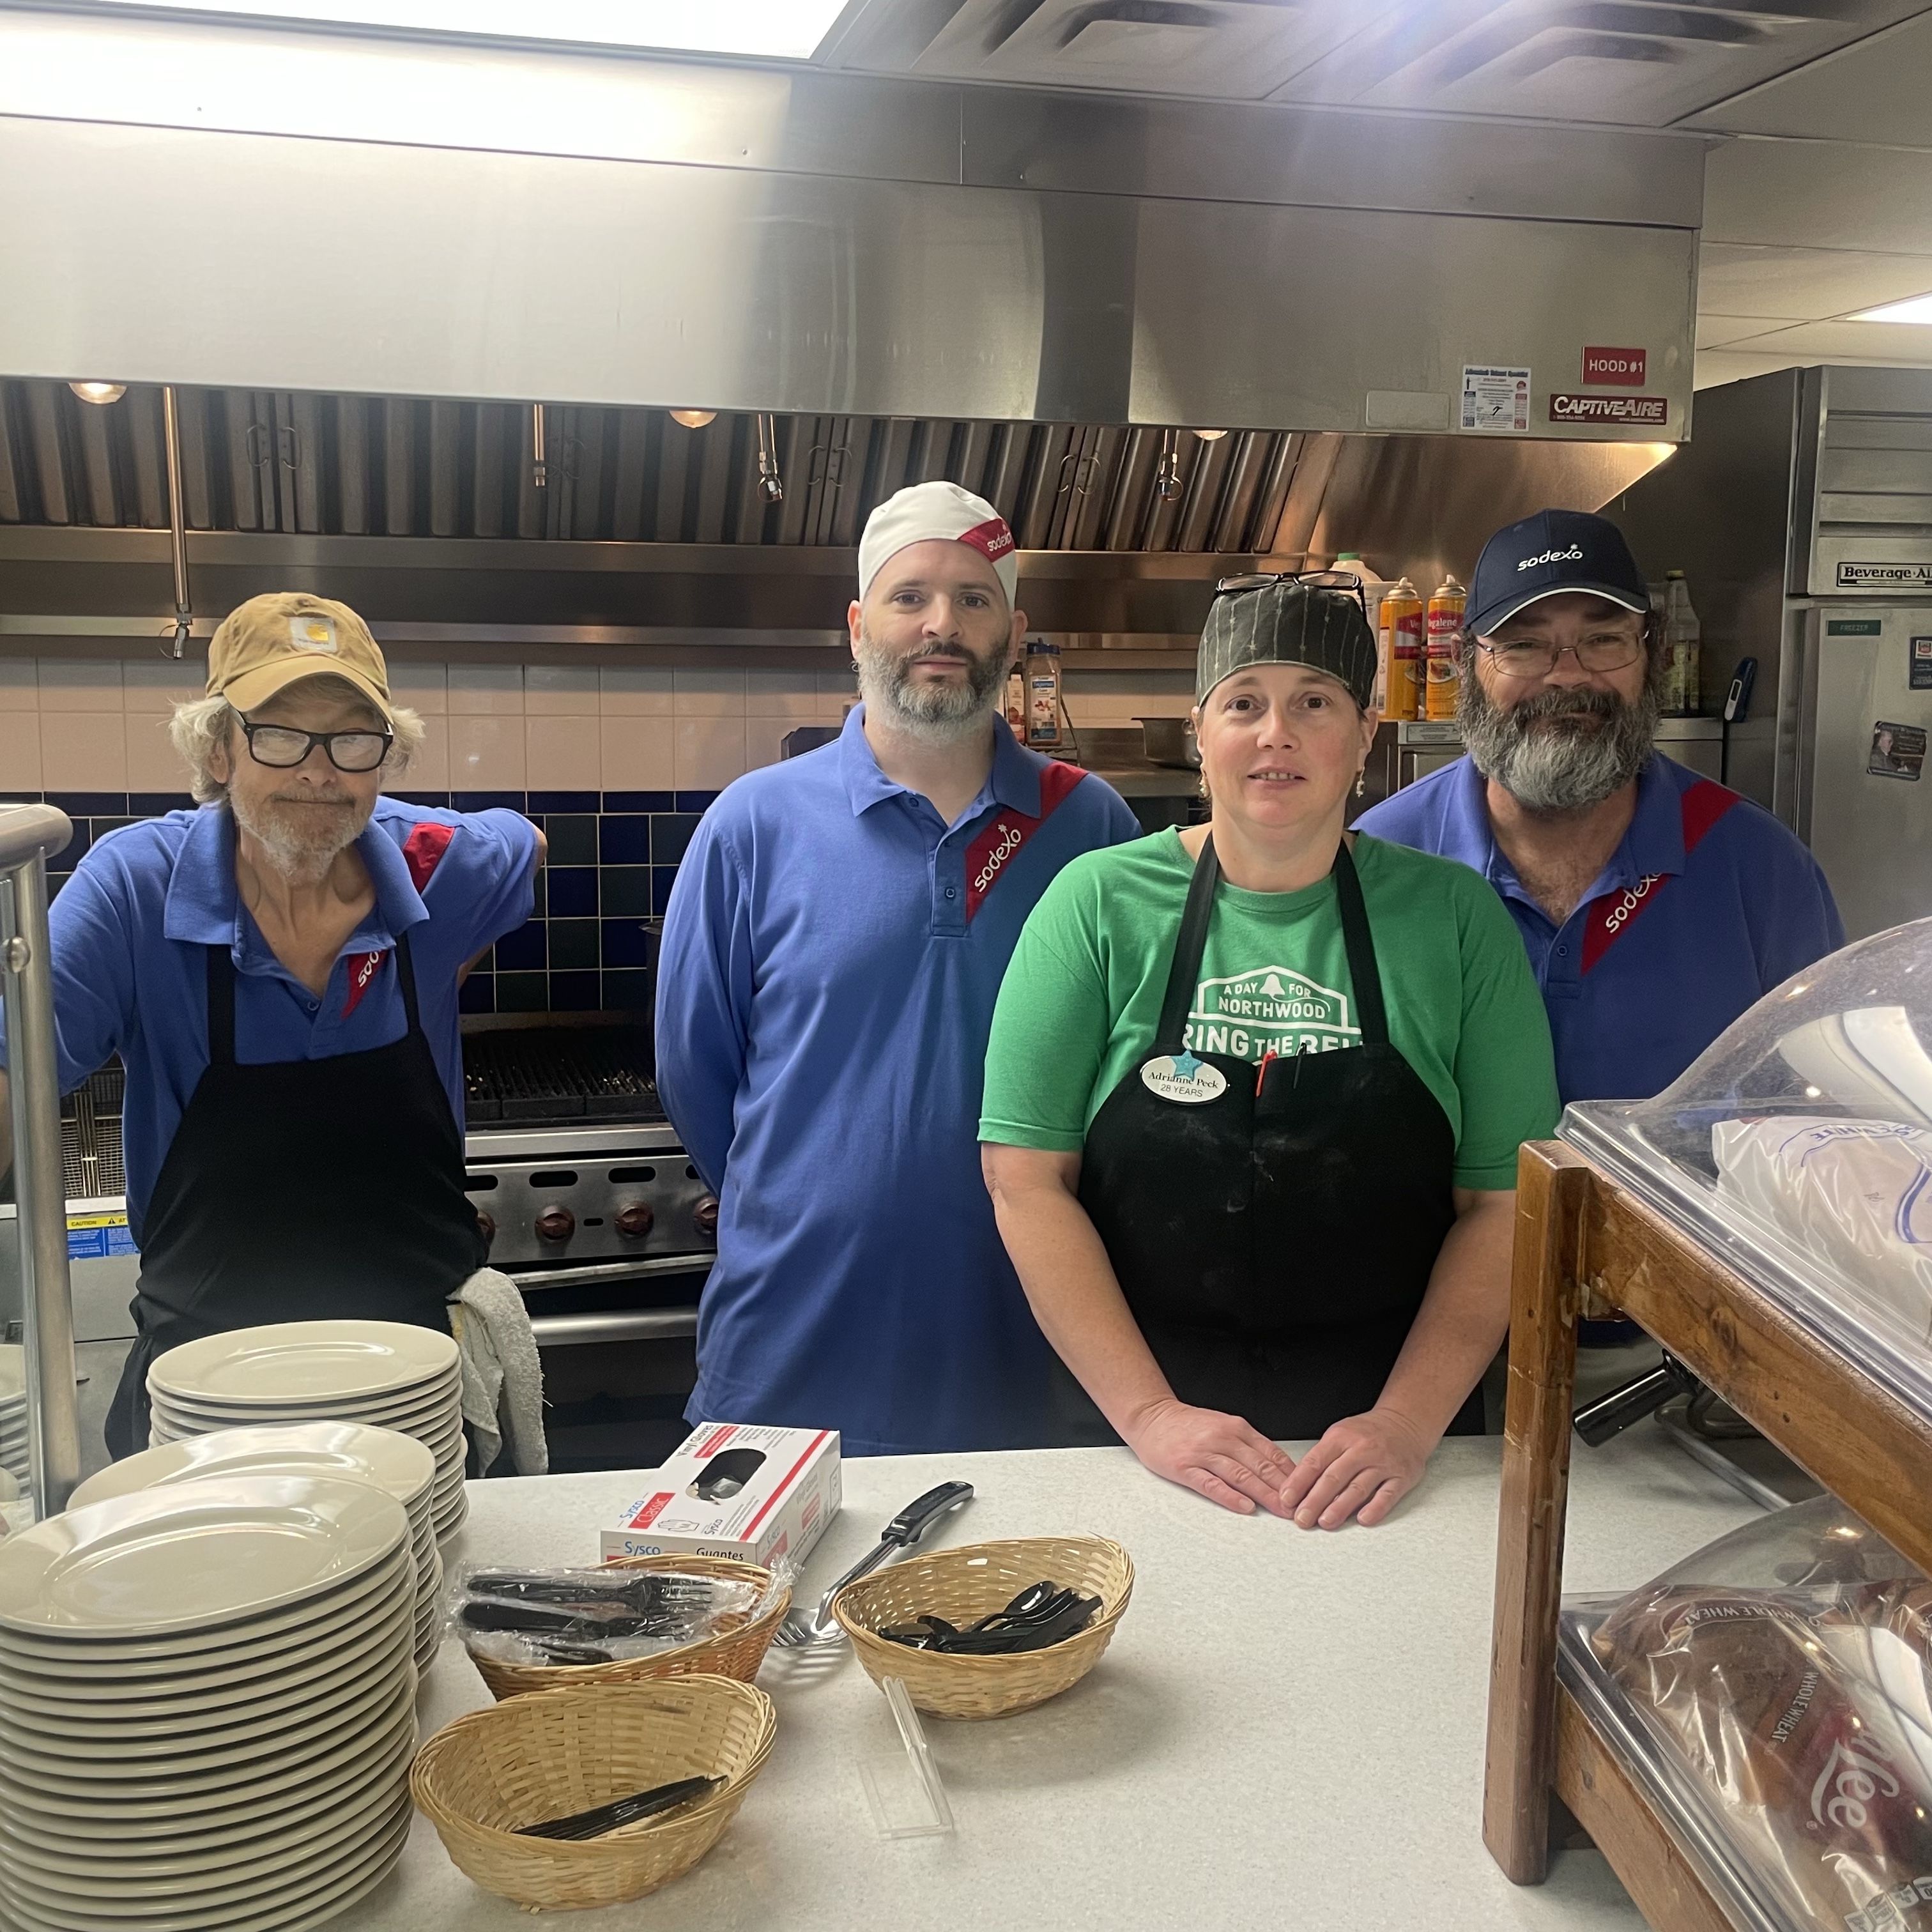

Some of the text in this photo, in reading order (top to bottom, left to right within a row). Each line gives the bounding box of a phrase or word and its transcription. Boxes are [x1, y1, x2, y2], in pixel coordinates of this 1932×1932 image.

[1588, 358, 1627, 372] HOOD
[986, 525, 1011, 552] sodexo
[1517, 544, 1583, 572] sodexo
[974, 824, 1022, 893] sodexo
[1606, 873, 1661, 933] sodex
[1223, 983, 1312, 998] A DAY FOR
[1218, 996, 1326, 1019] NORTHWOOD
[1254, 1036, 1293, 1057] THE
[1160, 1084, 1204, 1098] 28 YEARS
[1197, 1078, 1219, 1089] Peck
[619, 1499, 645, 1519] Sysco
[636, 1497, 670, 1524] Classic
[624, 1540, 661, 1556] Sysco
[696, 1547, 744, 1561] Guantes
[1684, 1606, 1740, 1626] WHEAT
[1771, 1671, 1820, 1743] WHOLE WHEAT
